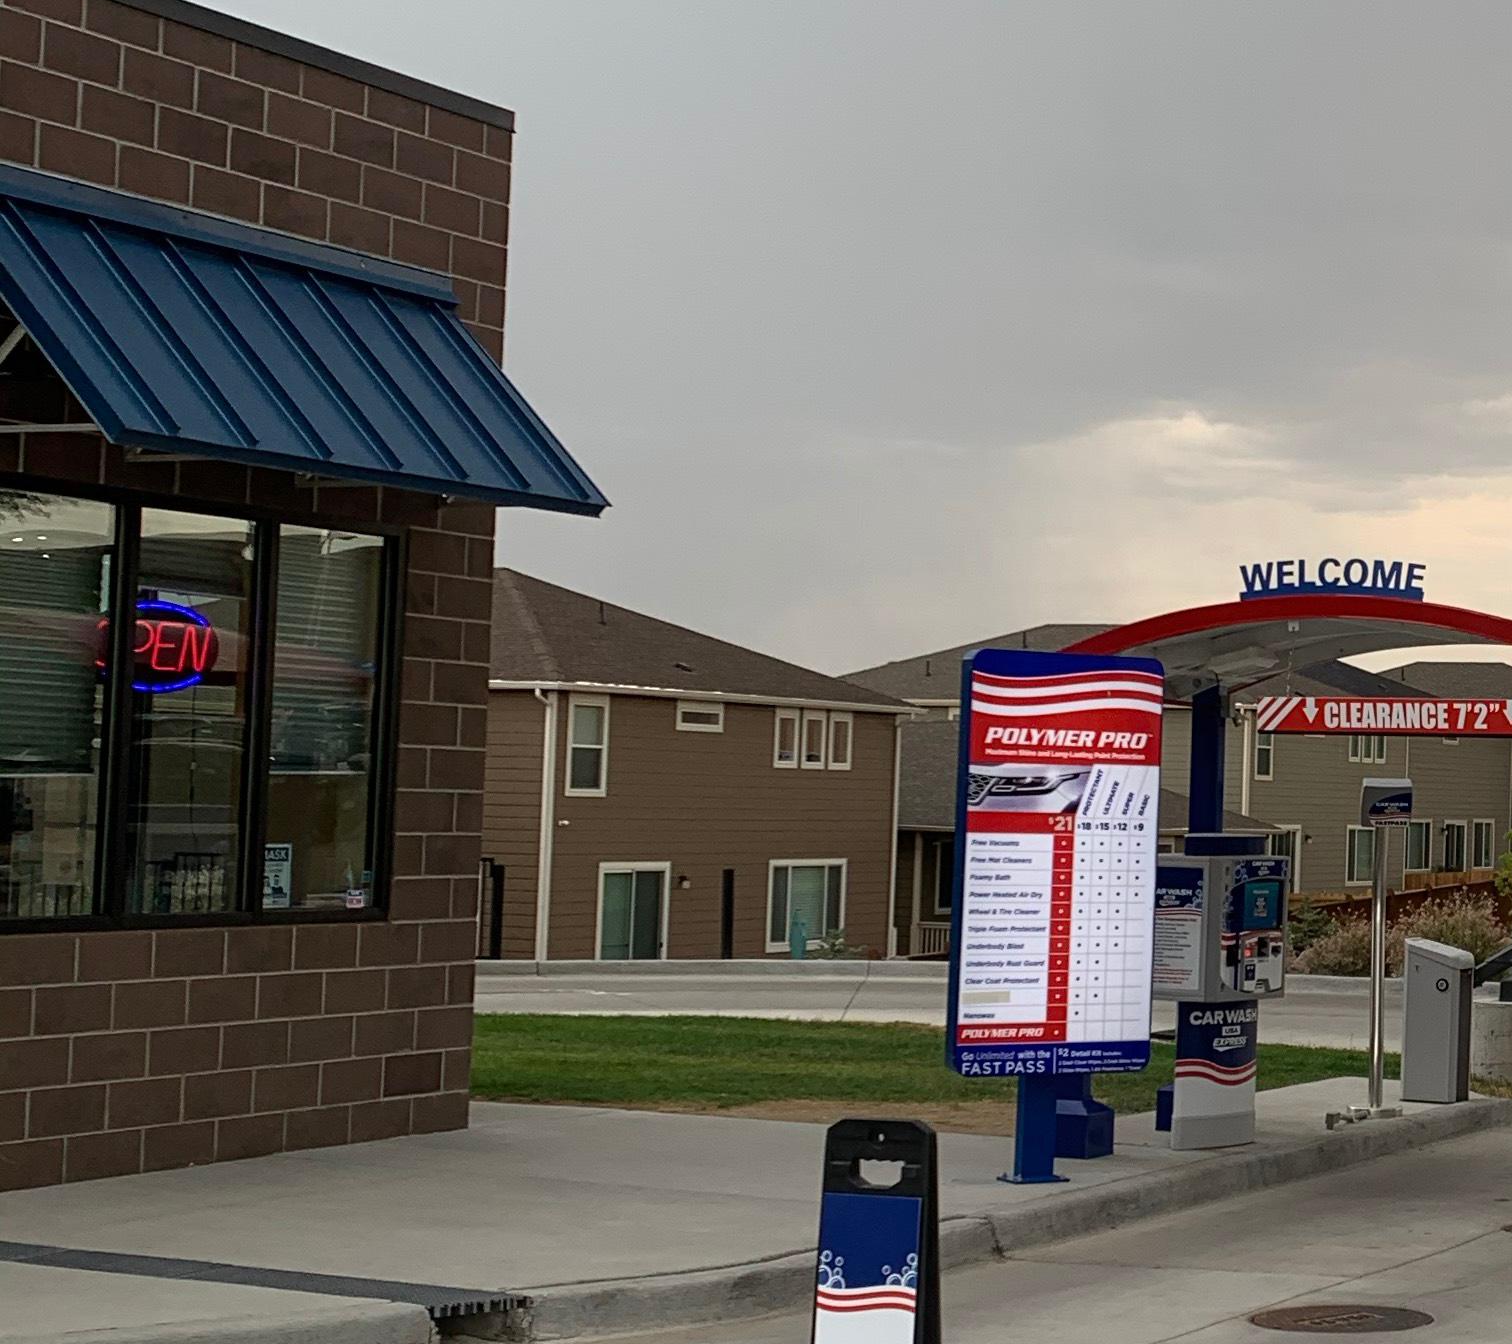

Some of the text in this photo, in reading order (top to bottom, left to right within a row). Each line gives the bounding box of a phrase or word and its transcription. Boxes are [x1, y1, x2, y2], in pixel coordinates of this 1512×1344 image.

[1240, 558, 1426, 592] WELCOME
[96, 619, 211, 672] PEN
[1324, 701, 1449, 730] CLEARANCE
[984, 727, 1148, 749] POLYMER PRO
[1083, 769, 1104, 816] PROTECTANT
[1103, 781, 1120, 815] ULTIMATE
[1122, 792, 1134, 815] SUPER
[1138, 795, 1151, 816] BASIC
[1049, 816, 1072, 832] $21
[1190, 1009, 1258, 1026] CAR WASH
[961, 1028, 1044, 1039] POLYMER PRO
[1213, 1037, 1248, 1048] EXPRESS
[962, 1052, 974, 1061] Go
[1018, 1050, 1035, 1059] with
[1037, 1050, 1050, 1059] the
[962, 1062, 1002, 1075] FAST
[1006, 1061, 1045, 1074] PASS
